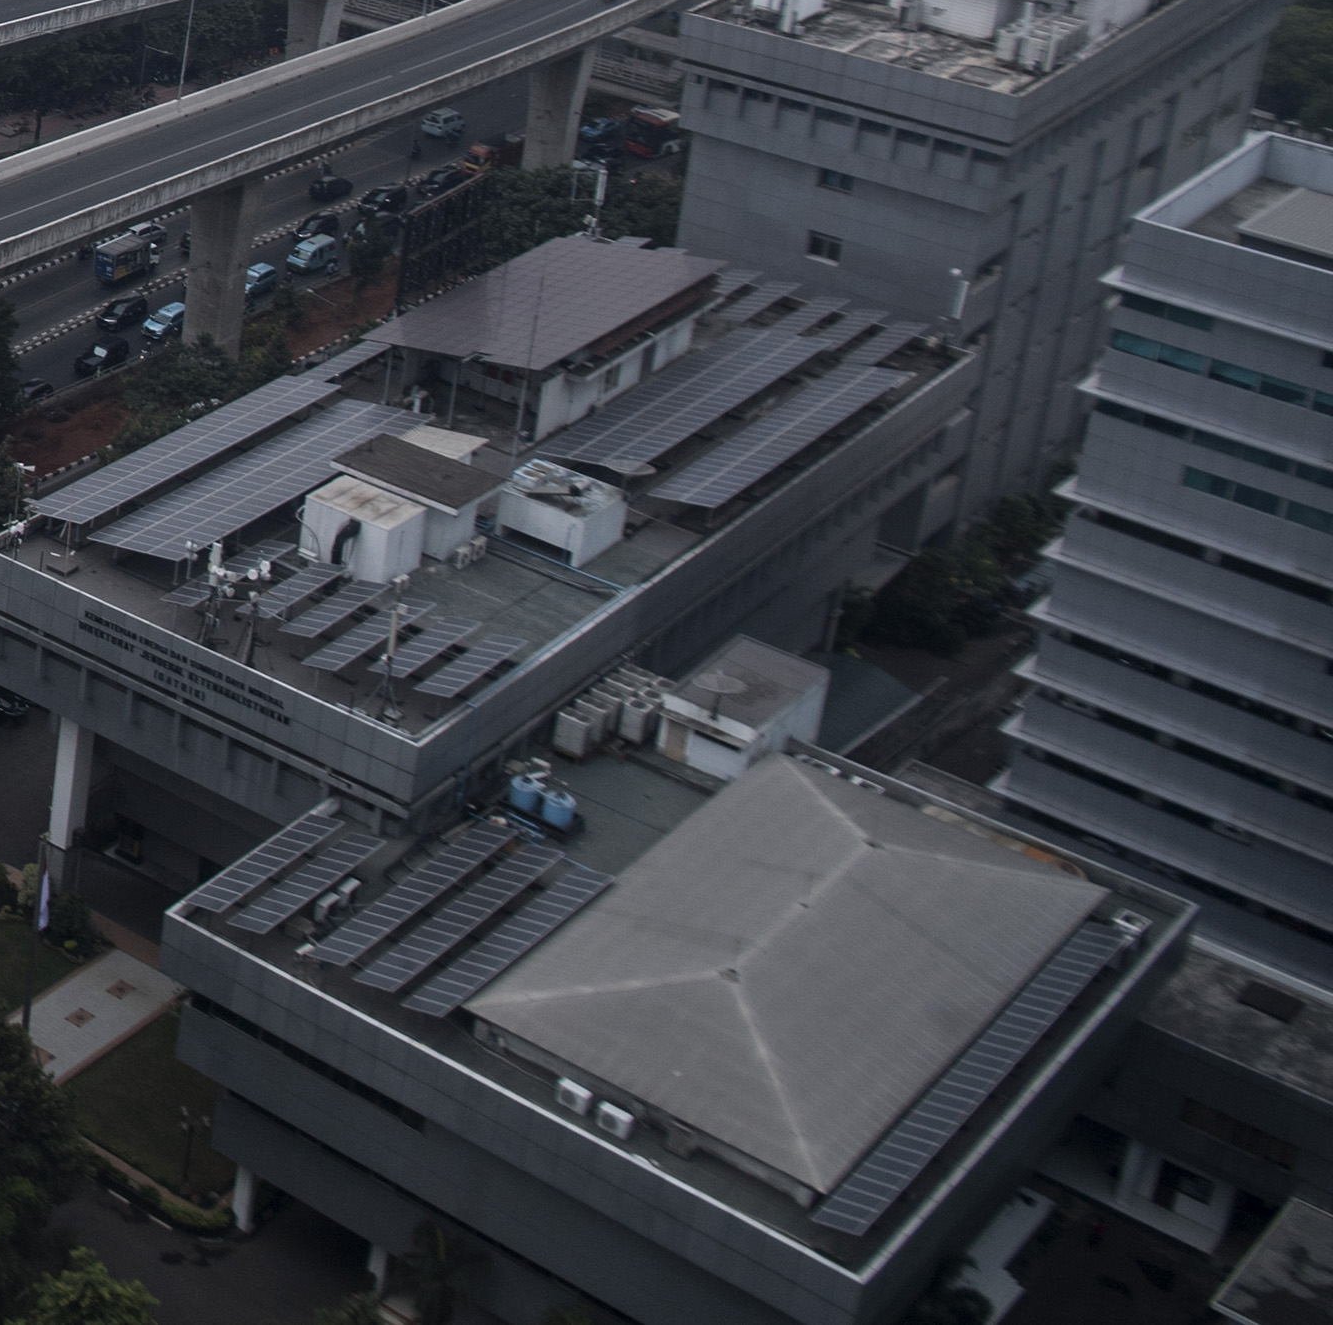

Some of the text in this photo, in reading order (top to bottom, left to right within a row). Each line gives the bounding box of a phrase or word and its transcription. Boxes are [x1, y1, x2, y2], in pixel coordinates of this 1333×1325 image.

[78, 619, 135, 653] DIREKTORAT
[138, 635, 169, 655] ENERGI
[169, 650, 188, 663] DAN
